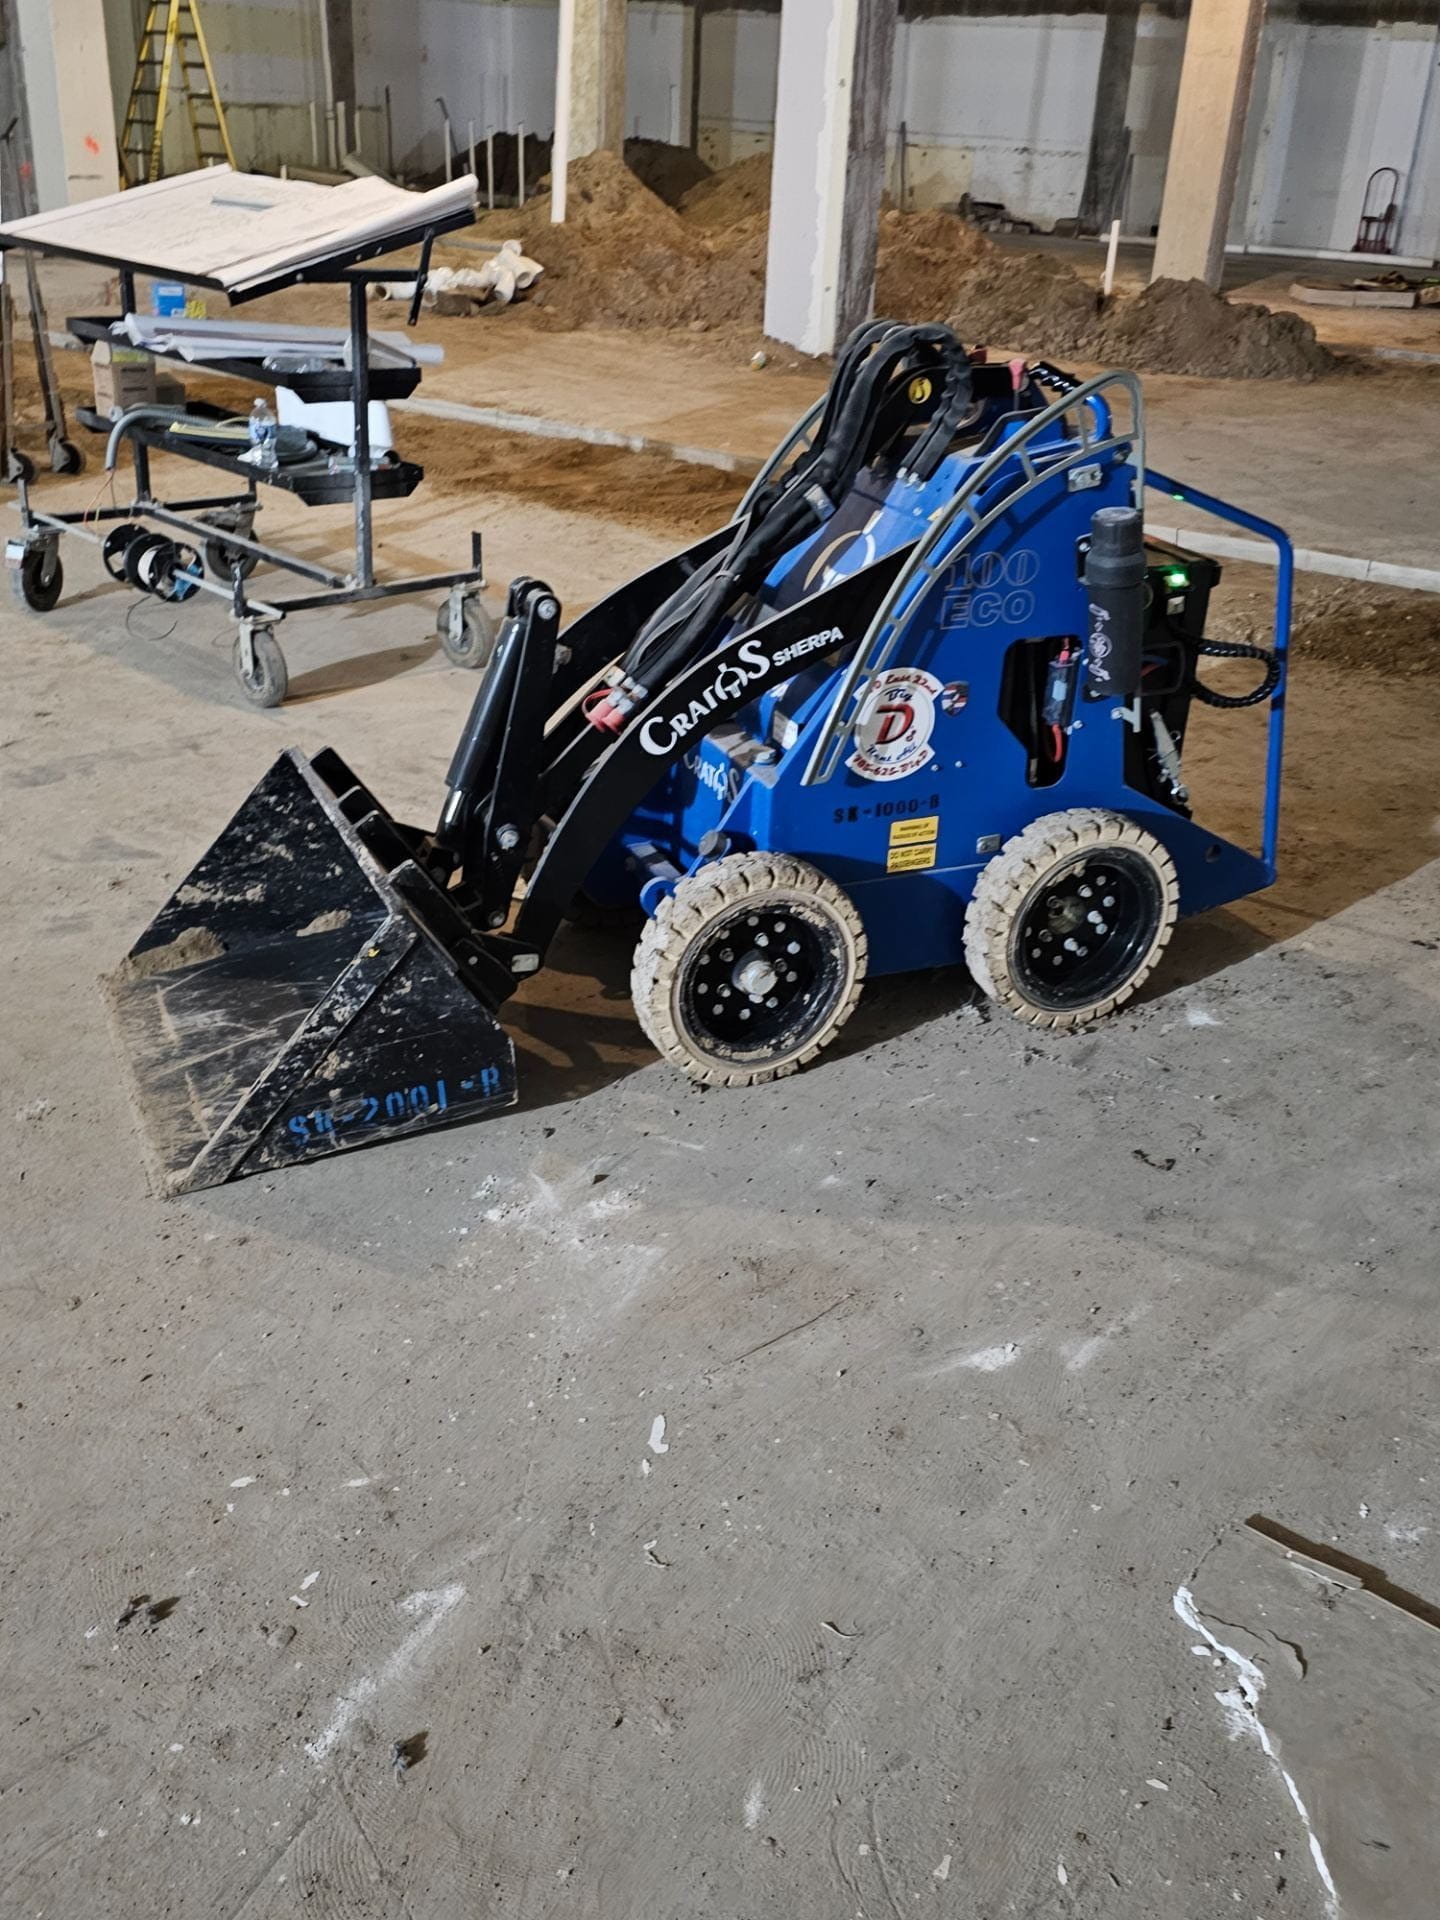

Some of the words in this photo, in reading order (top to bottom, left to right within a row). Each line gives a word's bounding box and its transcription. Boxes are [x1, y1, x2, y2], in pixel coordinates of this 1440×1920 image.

[945, 549, 1040, 591] 100
[940, 589, 1035, 630] ECO
[772, 627, 844, 667] SHERPA
[884, 688, 912, 701] Big
